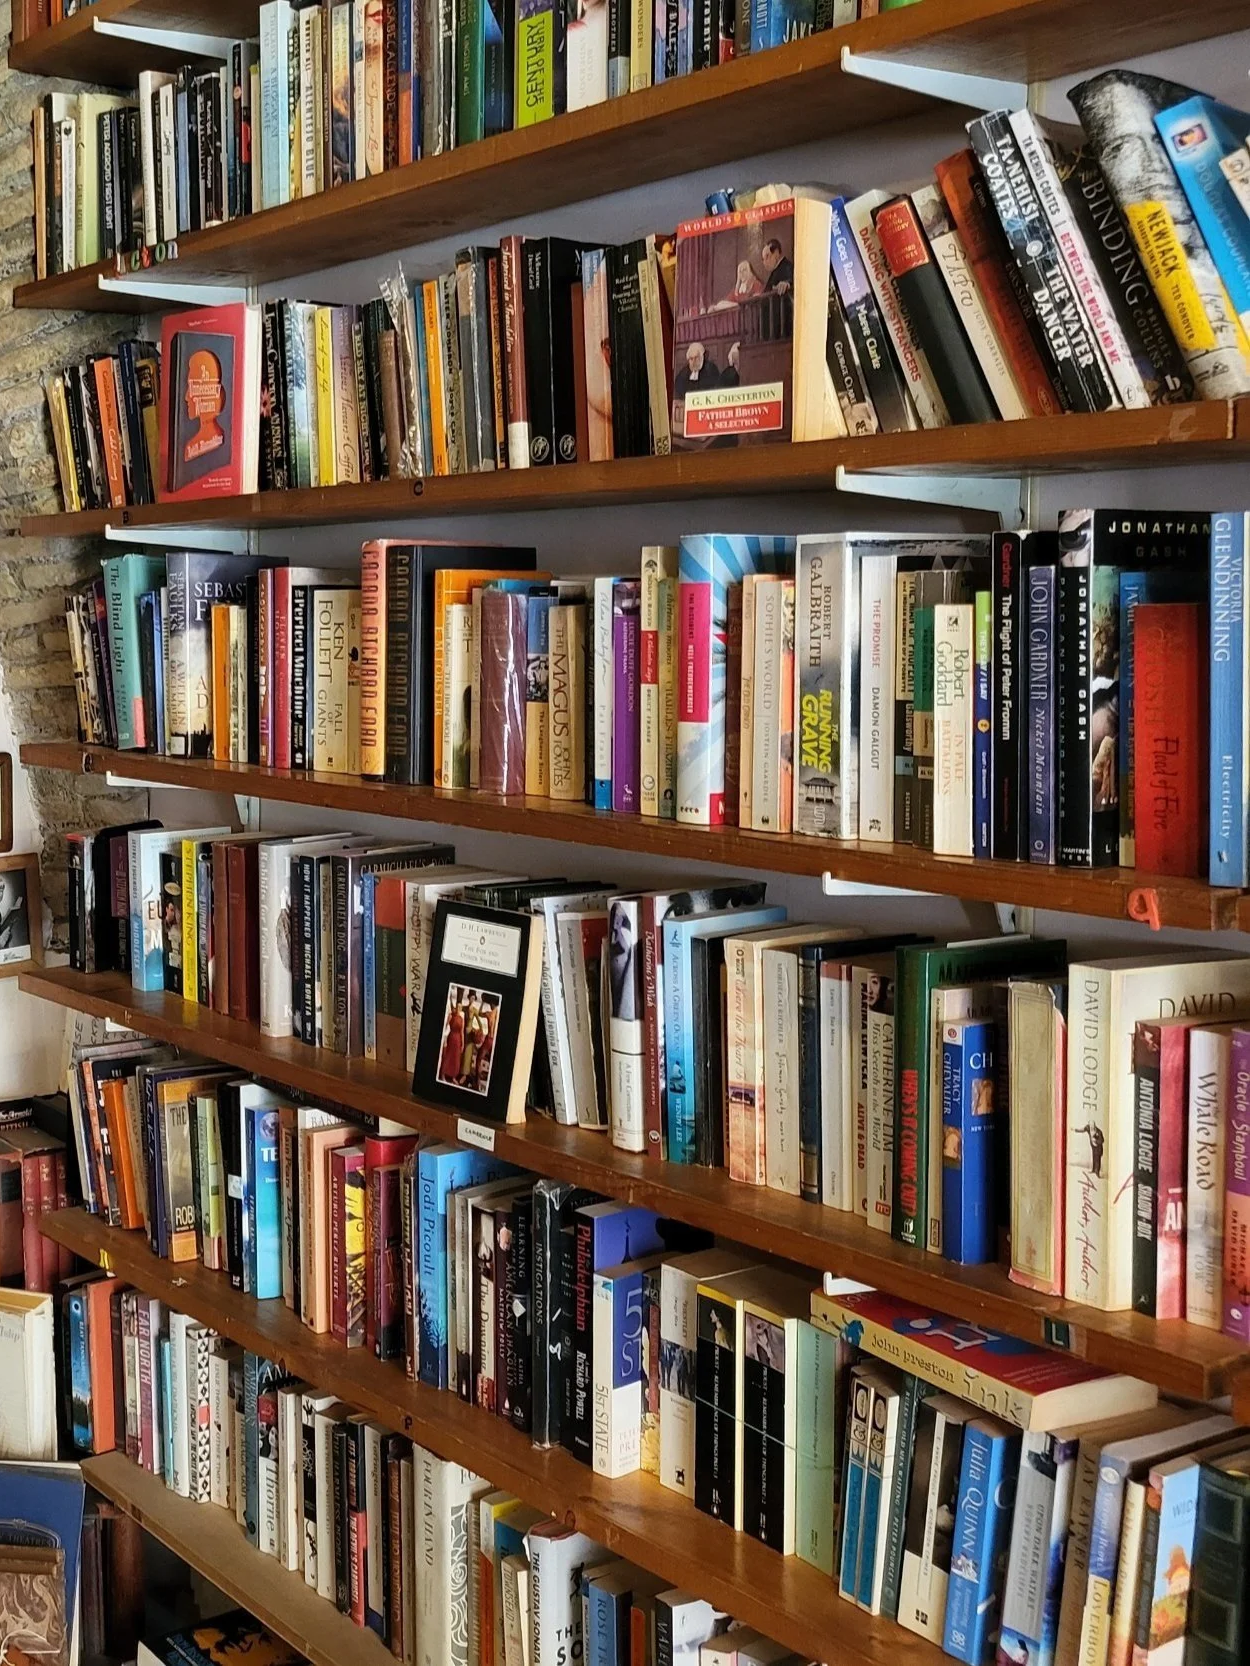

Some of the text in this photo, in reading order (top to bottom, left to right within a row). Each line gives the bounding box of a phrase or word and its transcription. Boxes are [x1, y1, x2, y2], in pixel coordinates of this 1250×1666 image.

[526, 24, 538, 107] CENTURY
[684, 201, 793, 233] WORLD'S CLASSICS
[983, 153, 1019, 220] COATES
[1082, 181, 1148, 306] BINDING
[1146, 208, 1182, 278] NEWJACK
[856, 304, 880, 369] Maeve Clarke
[859, 227, 921, 384] DANCING WITH STRANGERS
[1033, 289, 1071, 362] DANCER
[1046, 263, 1094, 368] THE WATER
[692, 389, 776, 406] G. K. CHESTERTON
[698, 407, 769, 422] FATHER BROWN
[1108, 521, 1212, 534] JONATHAN
[110, 565, 123, 675] The Blind Light
[809, 556, 823, 668] GALBRAITH
[823, 585, 832, 640] ROBERT
[1214, 519, 1231, 663] GLENDINNING
[1231, 557, 1241, 624] VICTORIA
[294, 601, 305, 719] Perfect Machine
[318, 600, 334, 684] FOLLETT
[333, 621, 344, 660] KEN
[361, 551, 379, 748] CANADA RICHARD FORD
[764, 594, 775, 710] SOPHIE'S WORLD
[936, 640, 953, 708] Goddard
[952, 649, 968, 700] Robert
[999, 542, 1013, 741] Gardner The Flight of Peter Fromm
[1078, 574, 1087, 741] JONATHAN GASH
[318, 690, 327, 747] GIANTS
[327, 703, 343, 735] FALL OF
[552, 628, 569, 737] THE MAGUS
[871, 599, 881, 770] THE PROMISE DAMON GALGUT
[1029, 578, 1049, 815] JOHN GARDNER Nickel Mountain
[553, 740, 565, 787] FOWLES
[562, 748, 570, 781] JOHN
[802, 693, 818, 769] GRAVE
[818, 689, 832, 774] RUNNING
[1220, 754, 1232, 841] Electricity
[1159, 992, 1236, 1018] DAVID
[1083, 979, 1099, 1112] DAVID LODGE
[170, 1106, 187, 1126] THE
[882, 1022, 894, 1152] CATHERINE LIM
[943, 1052, 952, 1115] CHEVALIER
[952, 1067, 960, 1104] TRACY
[1138, 1077, 1154, 1173] ANTONIA LOGUE
[1196, 1071, 1218, 1192] Whale Road
[421, 1172, 436, 1276] Jodi Picoult
[518, 1216, 526, 1278] LEARNING
[535, 1242, 543, 1324] INSTIGATIONS
[576, 1223, 591, 1331] Philadelphian
[138, 1309, 152, 1385] FAR NORTH
[871, 1333, 955, 1384] john preston
[1048, 1323, 1061, 1343] L
[575, 1350, 587, 1420] RICHARD POWELL
[264, 1464, 275, 1533] Thorne
[961, 1438, 988, 1553] Julia QUINN
[1074, 1454, 1096, 1570] JAY RAYNER
[532, 1551, 540, 1573] THE
[533, 1574, 541, 1618] GUSTAV
[556, 1622, 581, 1639] THE
